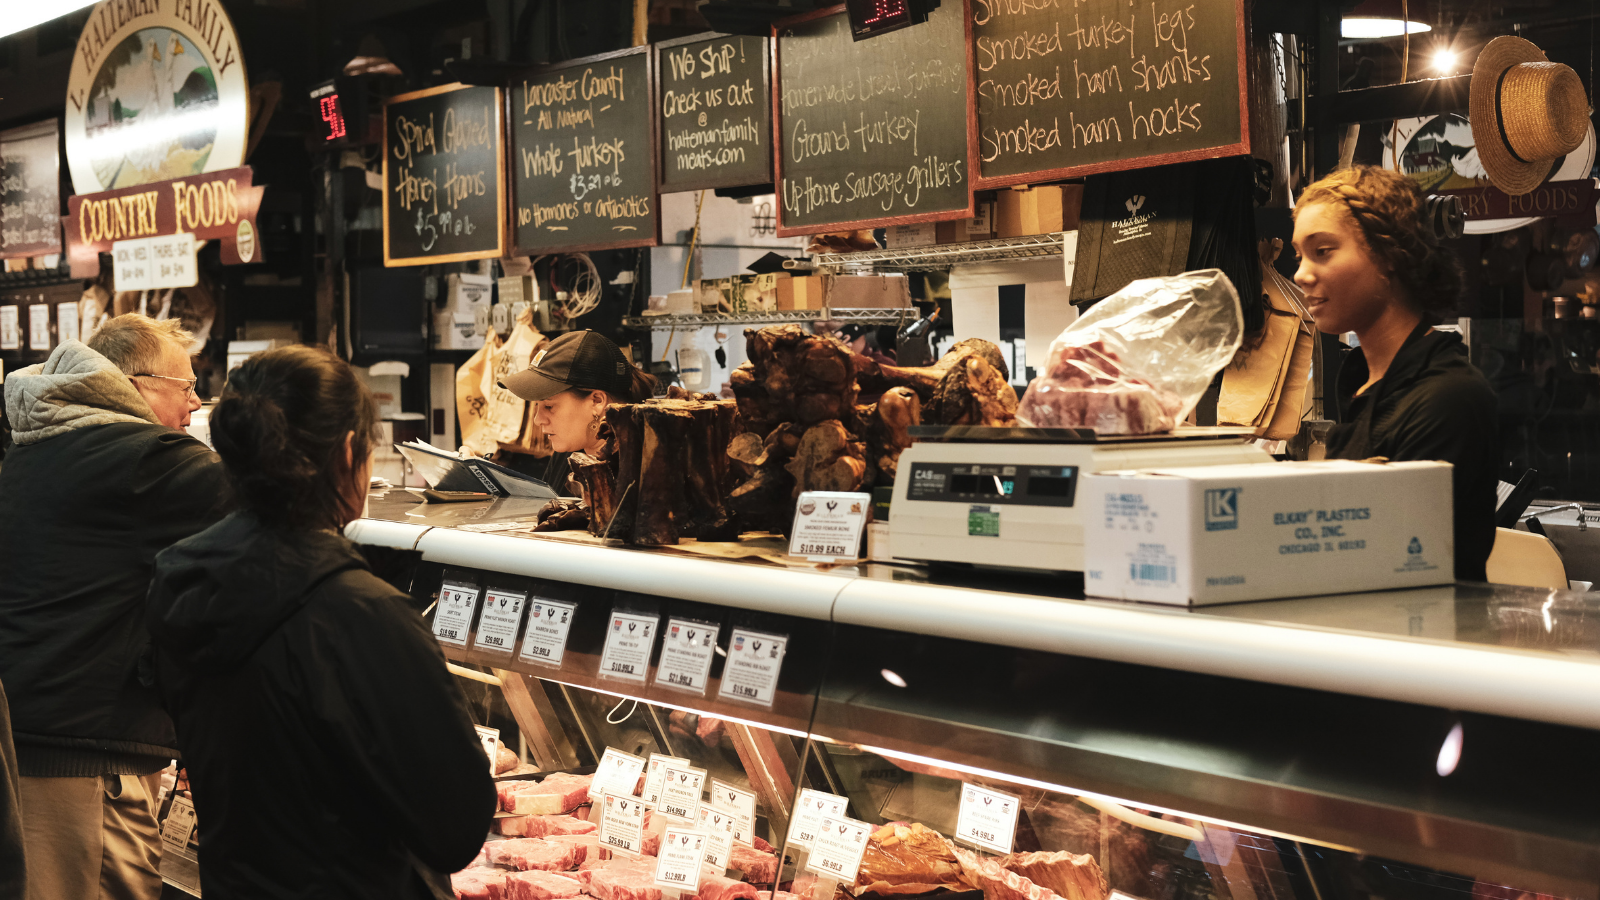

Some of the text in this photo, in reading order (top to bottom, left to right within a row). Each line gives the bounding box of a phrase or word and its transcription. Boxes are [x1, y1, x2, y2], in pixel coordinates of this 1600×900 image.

[174, 0, 235, 75] FAMILY
[977, 22, 1062, 72] Smoked
[1068, 14, 1135, 58] turkey
[1152, 4, 1195, 52] legs
[668, 49, 696, 81] We
[856, 61, 901, 102] bread
[524, 66, 625, 115] Lancaster County
[663, 79, 754, 118] Check us out
[978, 66, 1063, 115] Smoked
[1073, 59, 1123, 98] ham
[537, 102, 594, 130] All Natural
[668, 117, 760, 151] haltemanfamily
[698, 112, 708, 127] @
[791, 109, 920, 163] Ground turkey
[981, 98, 1201, 162] Smoked ham hocks
[394, 106, 492, 168] Spiral Glazed
[522, 136, 625, 178] Whole turkeys
[395, 162, 486, 215] Honey Hams
[570, 174, 601, 200] $3.29
[846, 172, 904, 211] Sausage
[904, 156, 962, 207] grillers
[1508, 187, 1578, 216] FOODS
[78, 191, 159, 247] COUNTRY
[172, 178, 238, 234] FOODS
[518, 207, 532, 227] No
[583, 200, 592, 214] or
[595, 195, 650, 218] antibiotics
[914, 470, 934, 480] CAS
[1316, 508, 1371, 522] PLASTICS
[800, 544, 846, 555] $10.99 EACH
[861, 769, 896, 778] BRUTE
